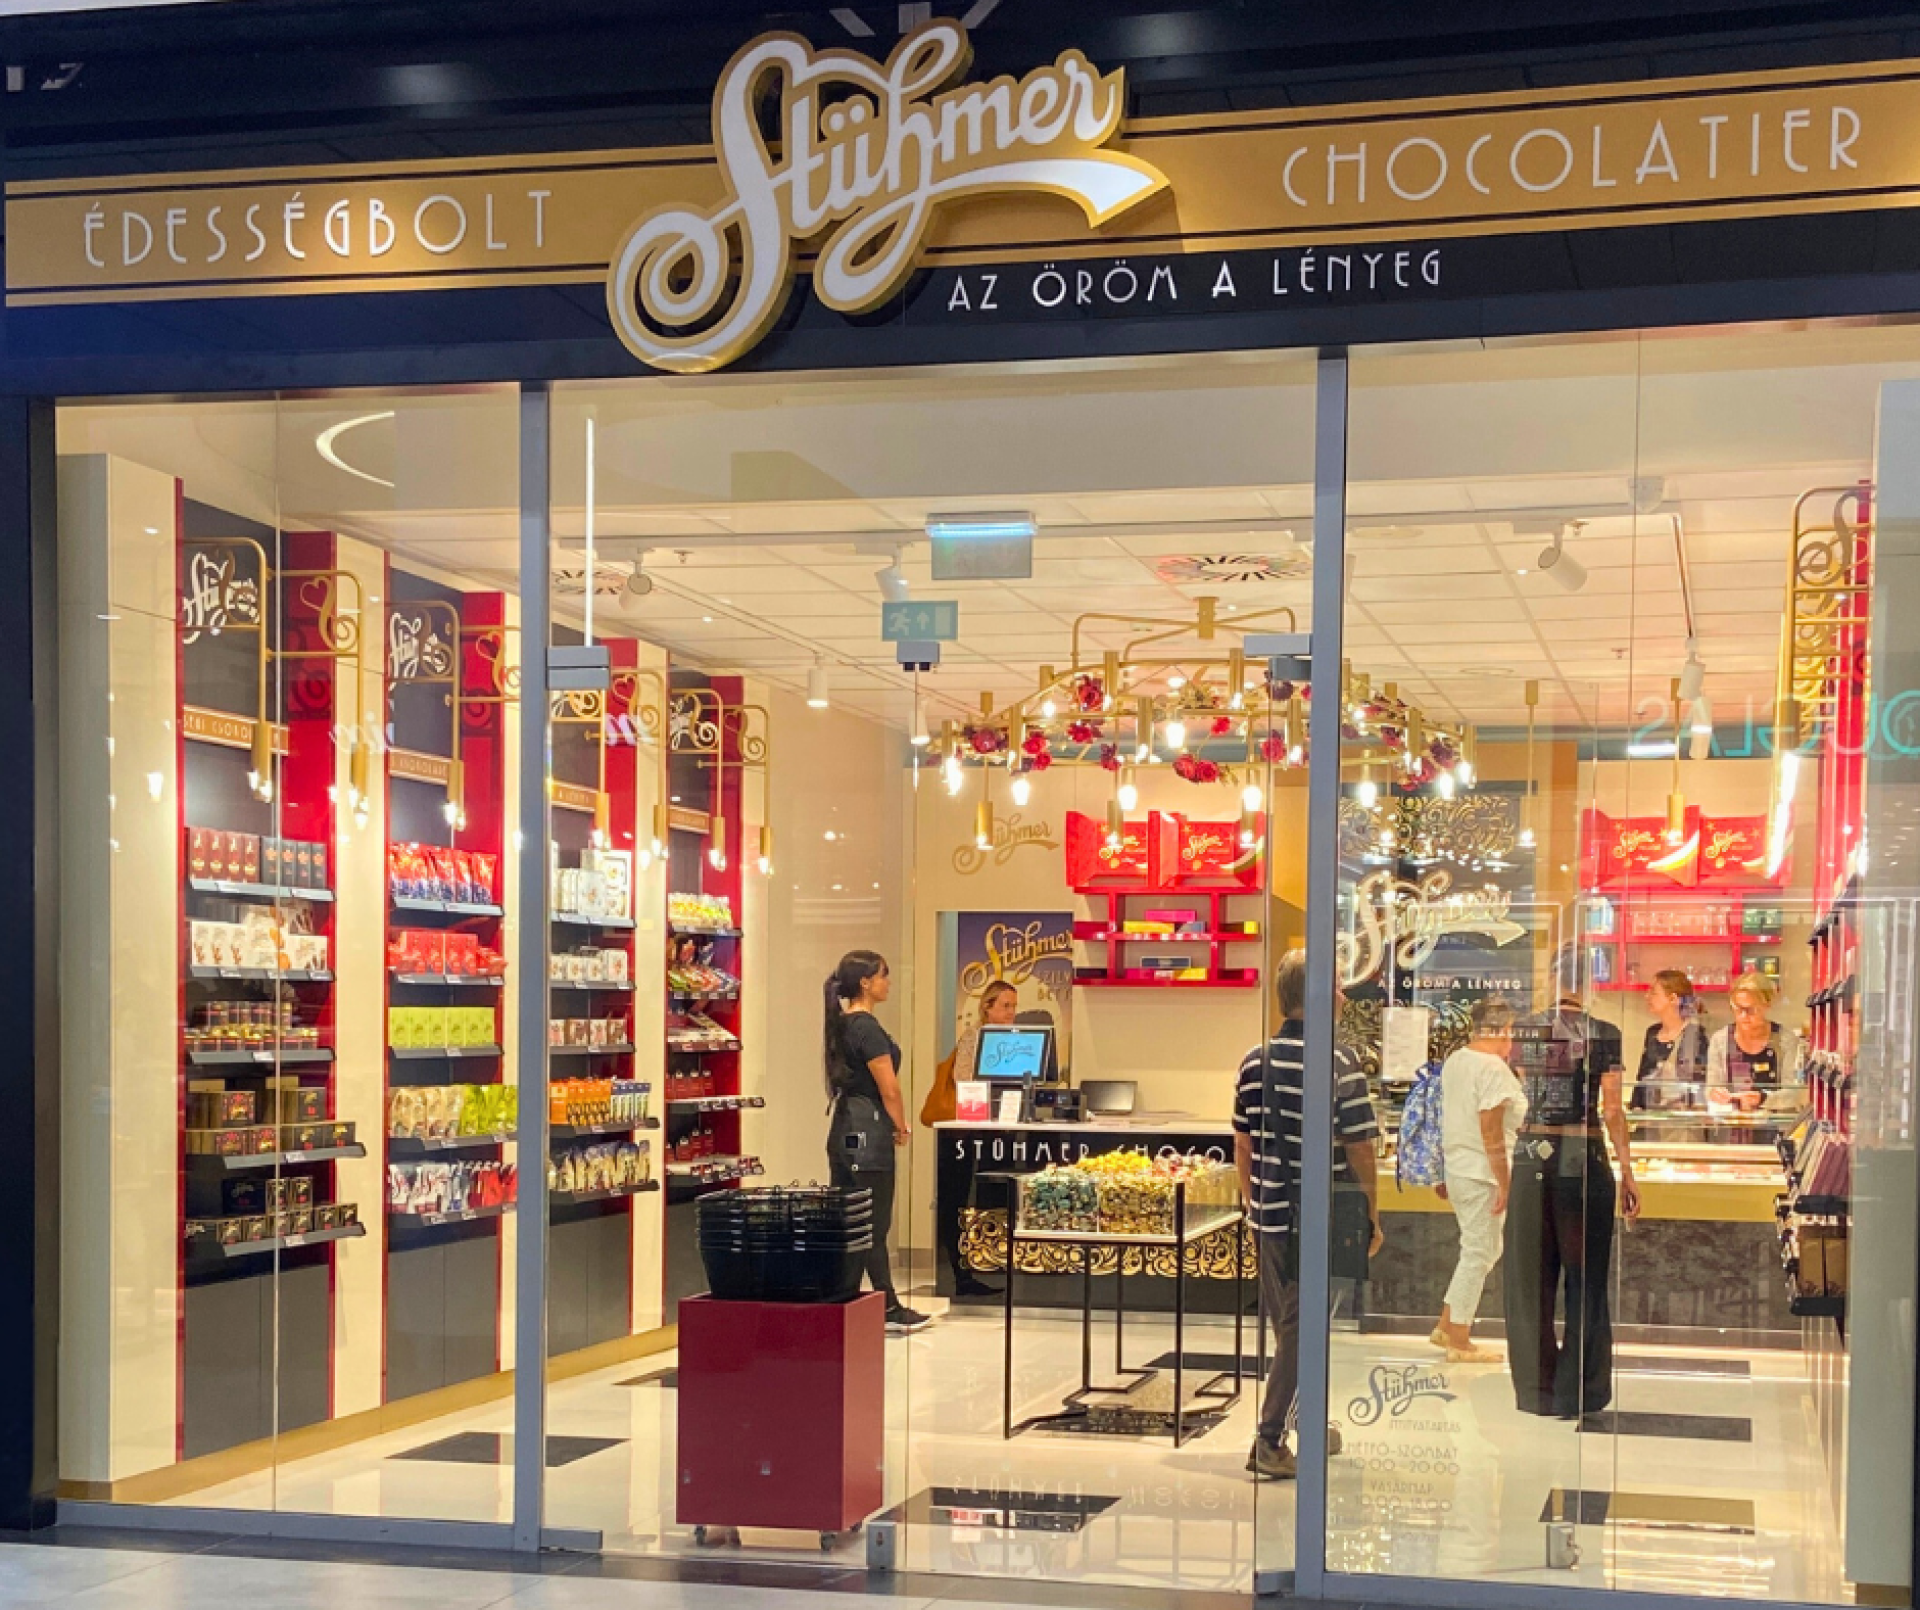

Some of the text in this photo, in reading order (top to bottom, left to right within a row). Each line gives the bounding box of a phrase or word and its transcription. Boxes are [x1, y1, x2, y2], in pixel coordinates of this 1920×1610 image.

[1282, 106, 1862, 206] CHOCOLATIER
[612, 20, 1165, 366] Stühmer
[82, 190, 553, 268] ÉDESSÉGBOLT
[948, 248, 1441, 311] AZ ÖRÖM A LÉNYEG
[952, 812, 1060, 875] Sühmer
[1348, 1364, 1458, 1426] Stühmer
